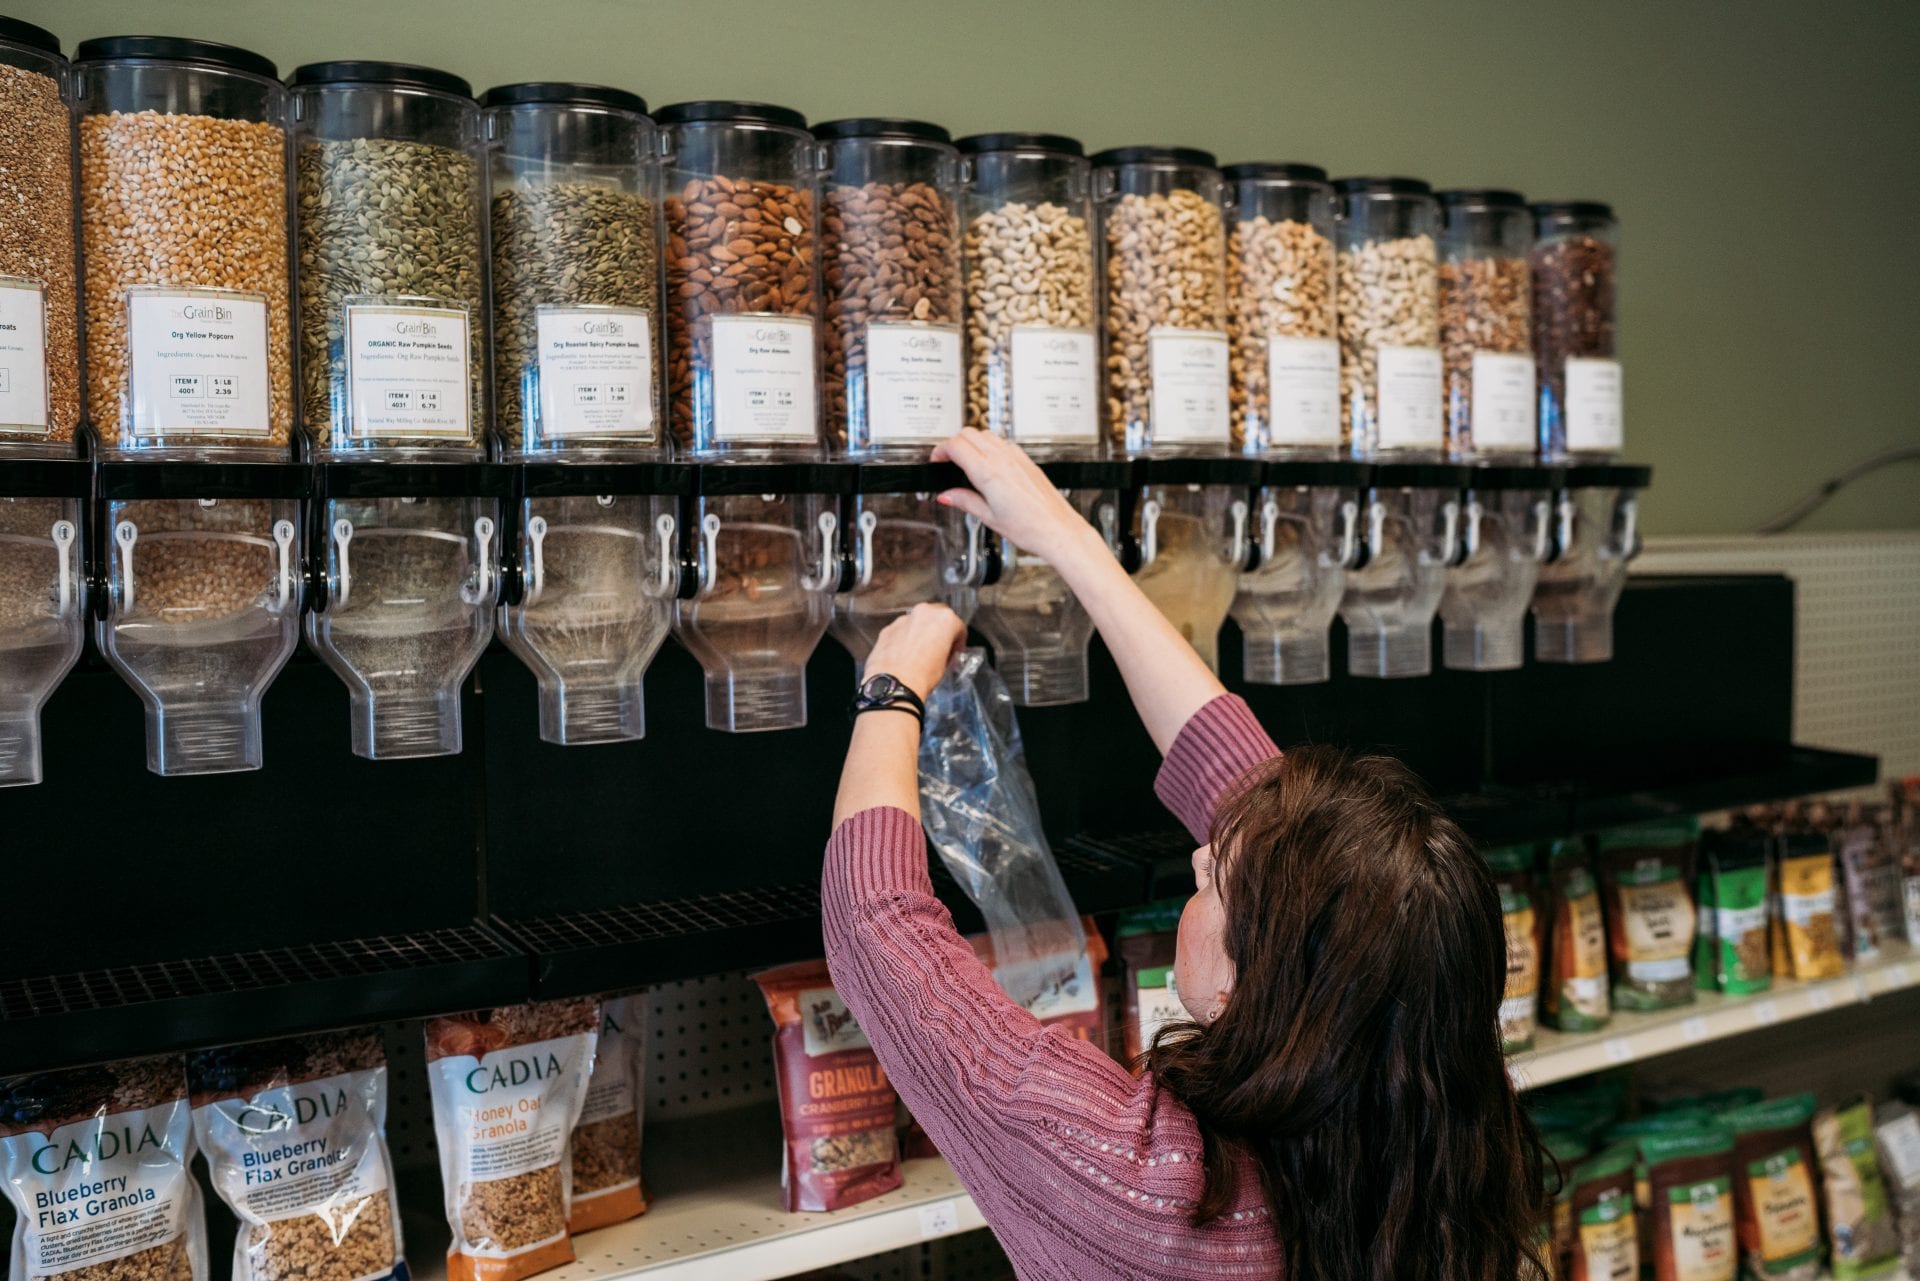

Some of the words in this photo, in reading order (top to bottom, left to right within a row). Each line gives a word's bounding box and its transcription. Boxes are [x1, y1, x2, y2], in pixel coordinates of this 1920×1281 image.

[171, 331, 184, 339] Org
[186, 331, 207, 339] Yellow
[208, 332, 234, 340] Popcorn
[412, 342, 437, 350] Pumpkin
[553, 341, 564, 349] Org
[605, 341, 627, 349] Pumpkin
[465, 1052, 562, 1094] CADIA
[808, 1063, 887, 1099] GRANOLA
[31, 1122, 161, 1175] CADIA
[243, 1137, 328, 1168] Blueberry
[244, 1167, 282, 1185] Flax
[287, 1149, 347, 1176] Granola
[35, 1175, 127, 1209] Blueberry
[38, 1207, 79, 1229] Flax
[86, 1187, 156, 1216] Granola
[41, 1241, 65, 1251] clusters,
[65, 1237, 81, 1246] dried
[81, 1229, 112, 1241] blueberries
[113, 1225, 123, 1233] and
[46, 1234, 60, 1242] light
[60, 1232, 71, 1240] and
[72, 1226, 95, 1237] crunchy
[95, 1220, 111, 1230] blend
[118, 1216, 132, 1224] whole
[133, 1212, 147, 1221] grain
[62, 1242, 90, 1253] Blueberry
[103, 1233, 125, 1242] Granola
[136, 1223, 154, 1235] perfect
[41, 1257, 56, 1265] start
[56, 1254, 70, 1263] your
[70, 1251, 82, 1259] day
[105, 1238, 131, 1248] on-the-go
